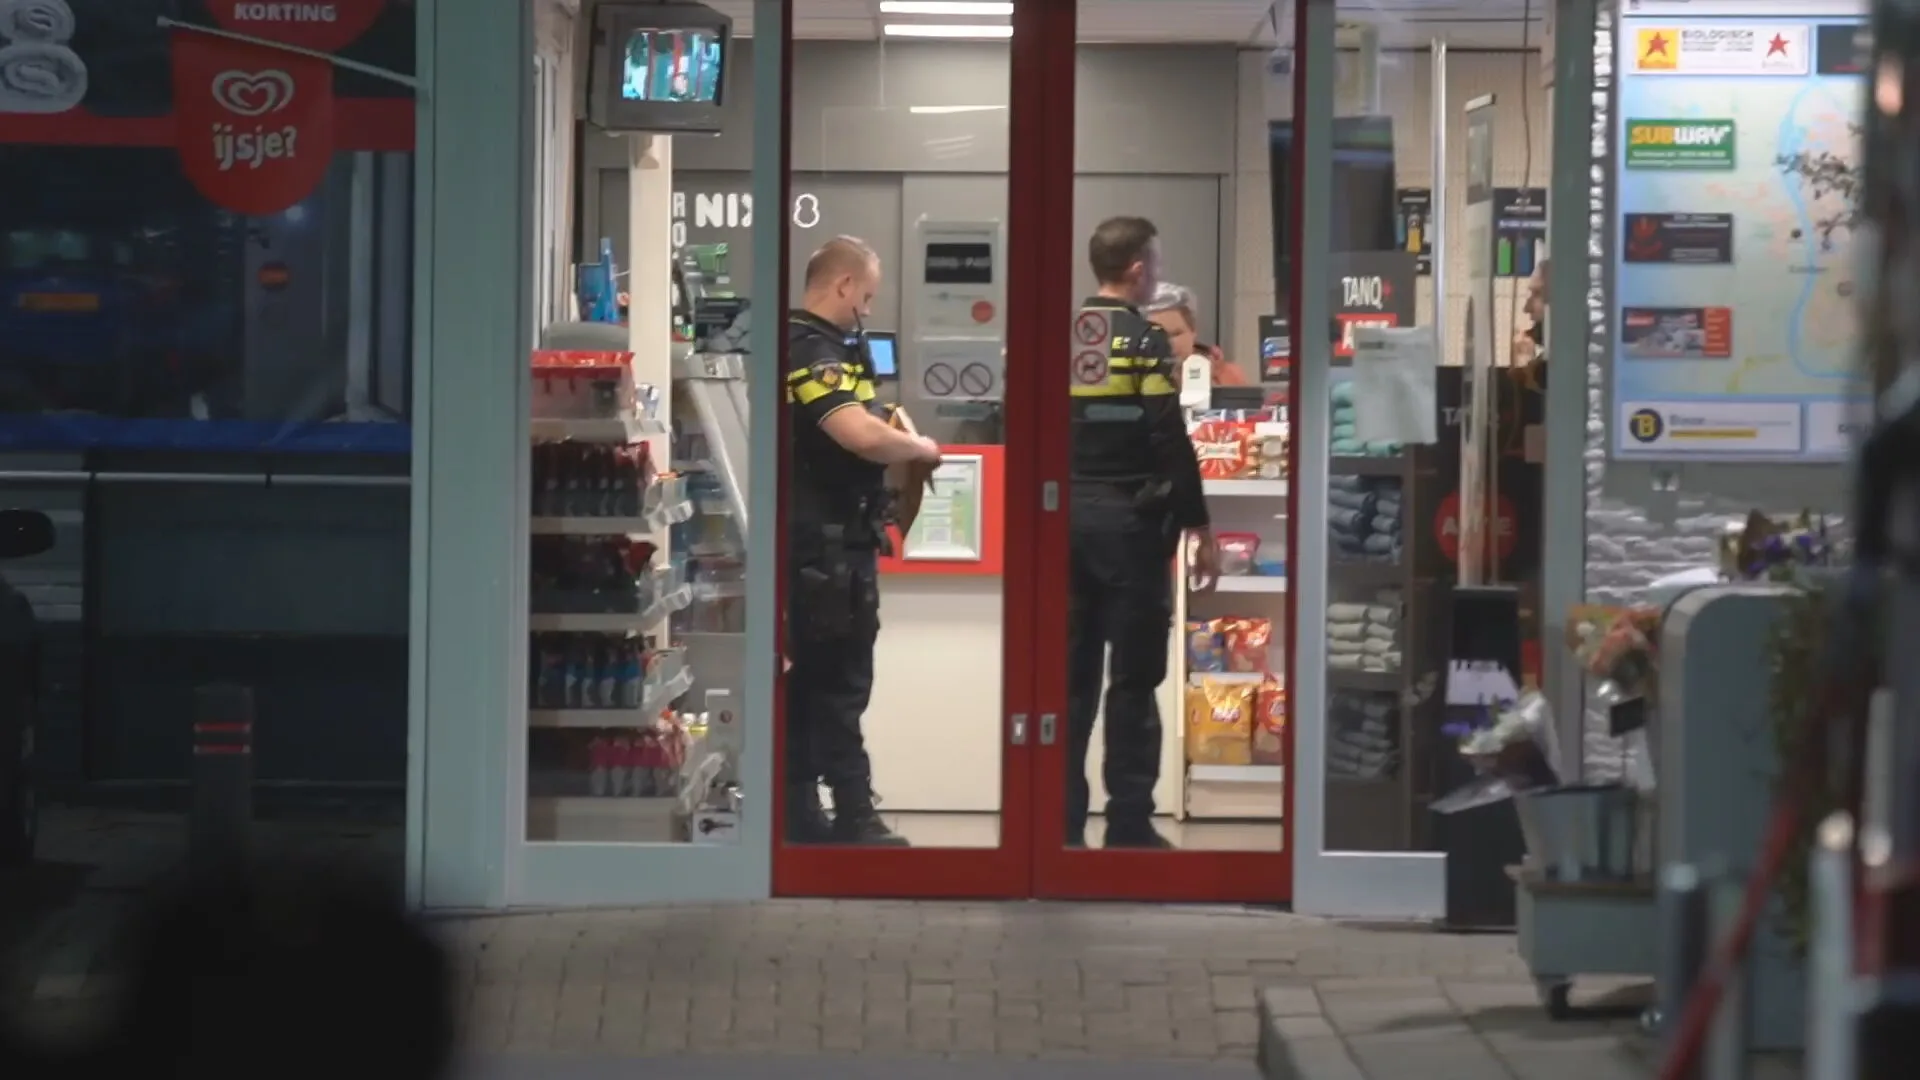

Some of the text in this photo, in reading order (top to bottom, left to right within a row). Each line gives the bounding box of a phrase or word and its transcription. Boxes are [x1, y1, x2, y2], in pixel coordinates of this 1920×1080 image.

[234, 3, 337, 22] KORTING
[212, 123, 297, 170] ijsje?
[1630, 125, 1731, 146] SUBWAY
[1341, 276, 1383, 310] TANQ
